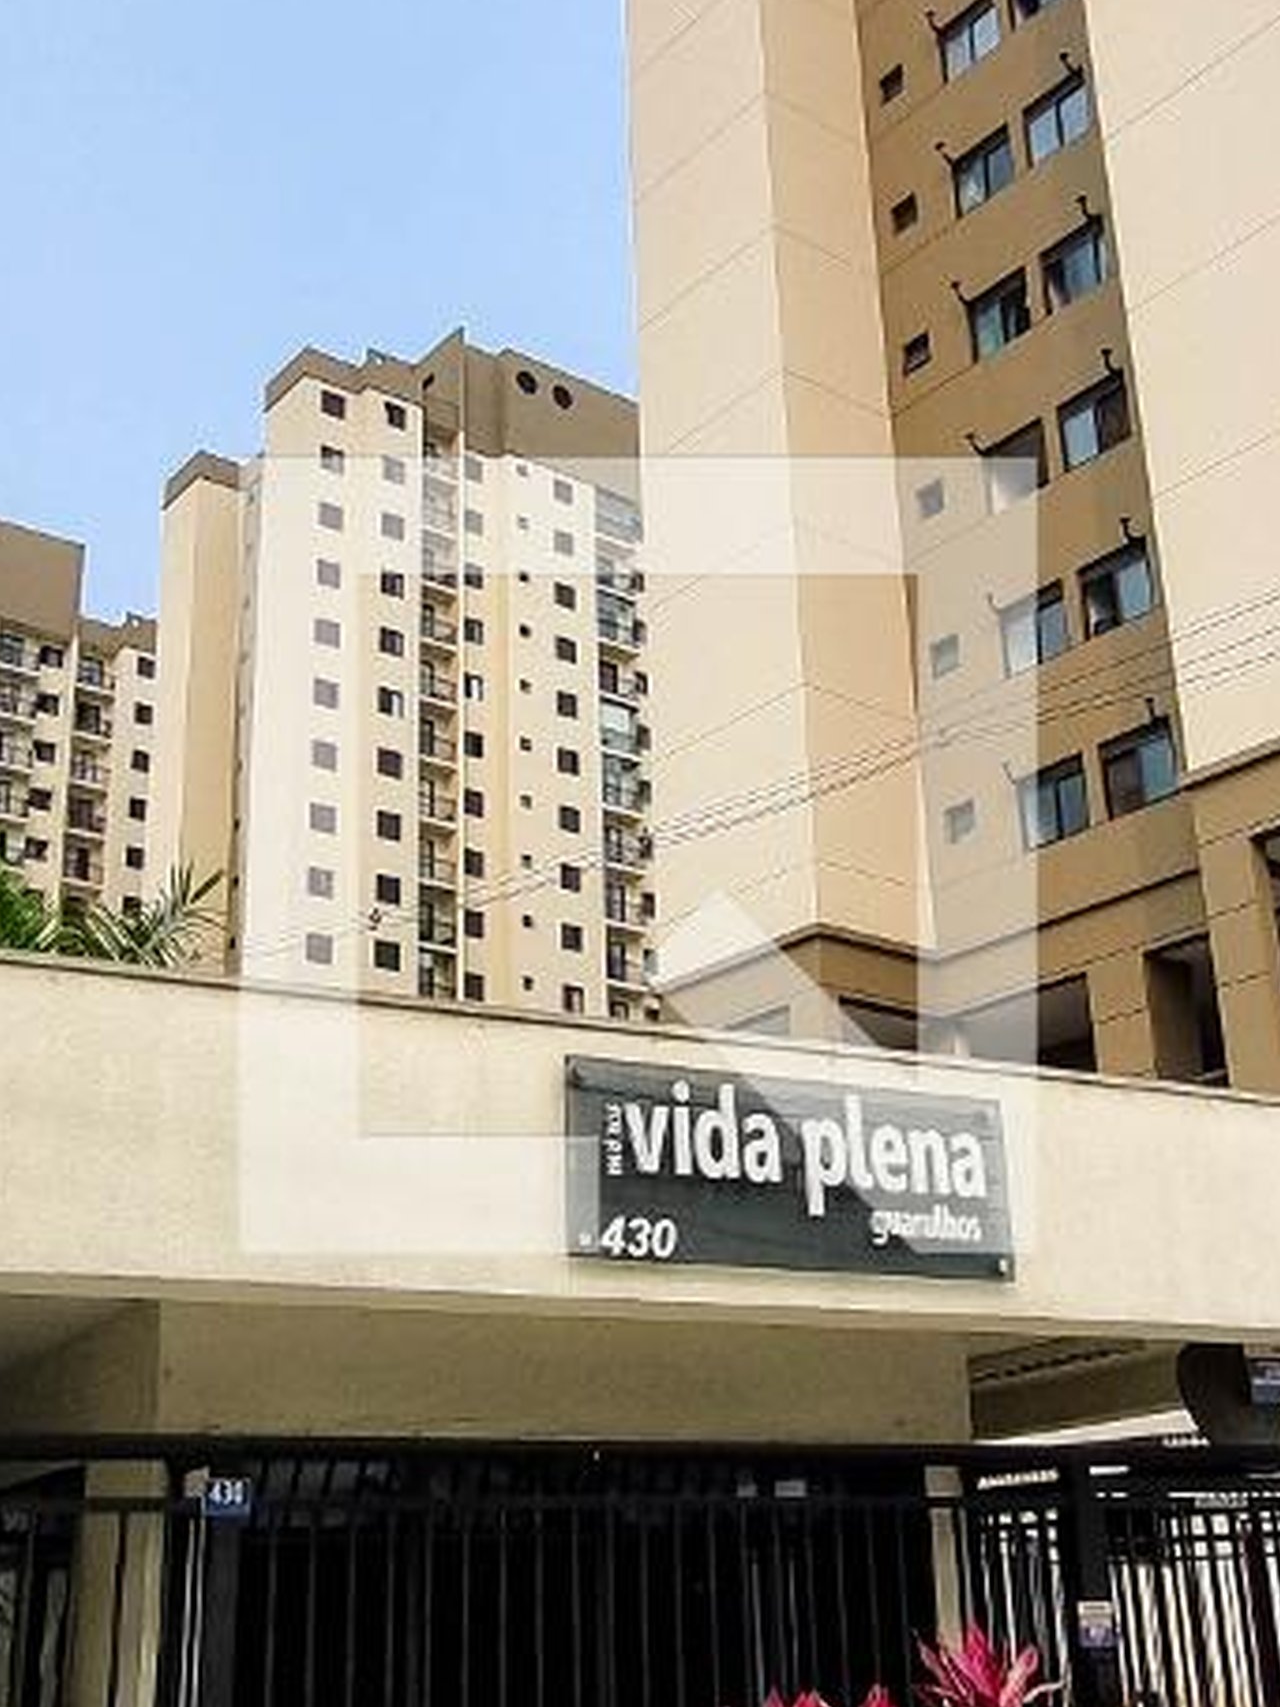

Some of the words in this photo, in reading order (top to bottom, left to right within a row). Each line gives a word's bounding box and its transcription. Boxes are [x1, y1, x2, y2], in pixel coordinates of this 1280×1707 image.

[623, 1079, 783, 1183] vida
[801, 1093, 987, 1216] plena
[601, 1215, 677, 1257] 430
[871, 1203, 983, 1244] guarulhos
